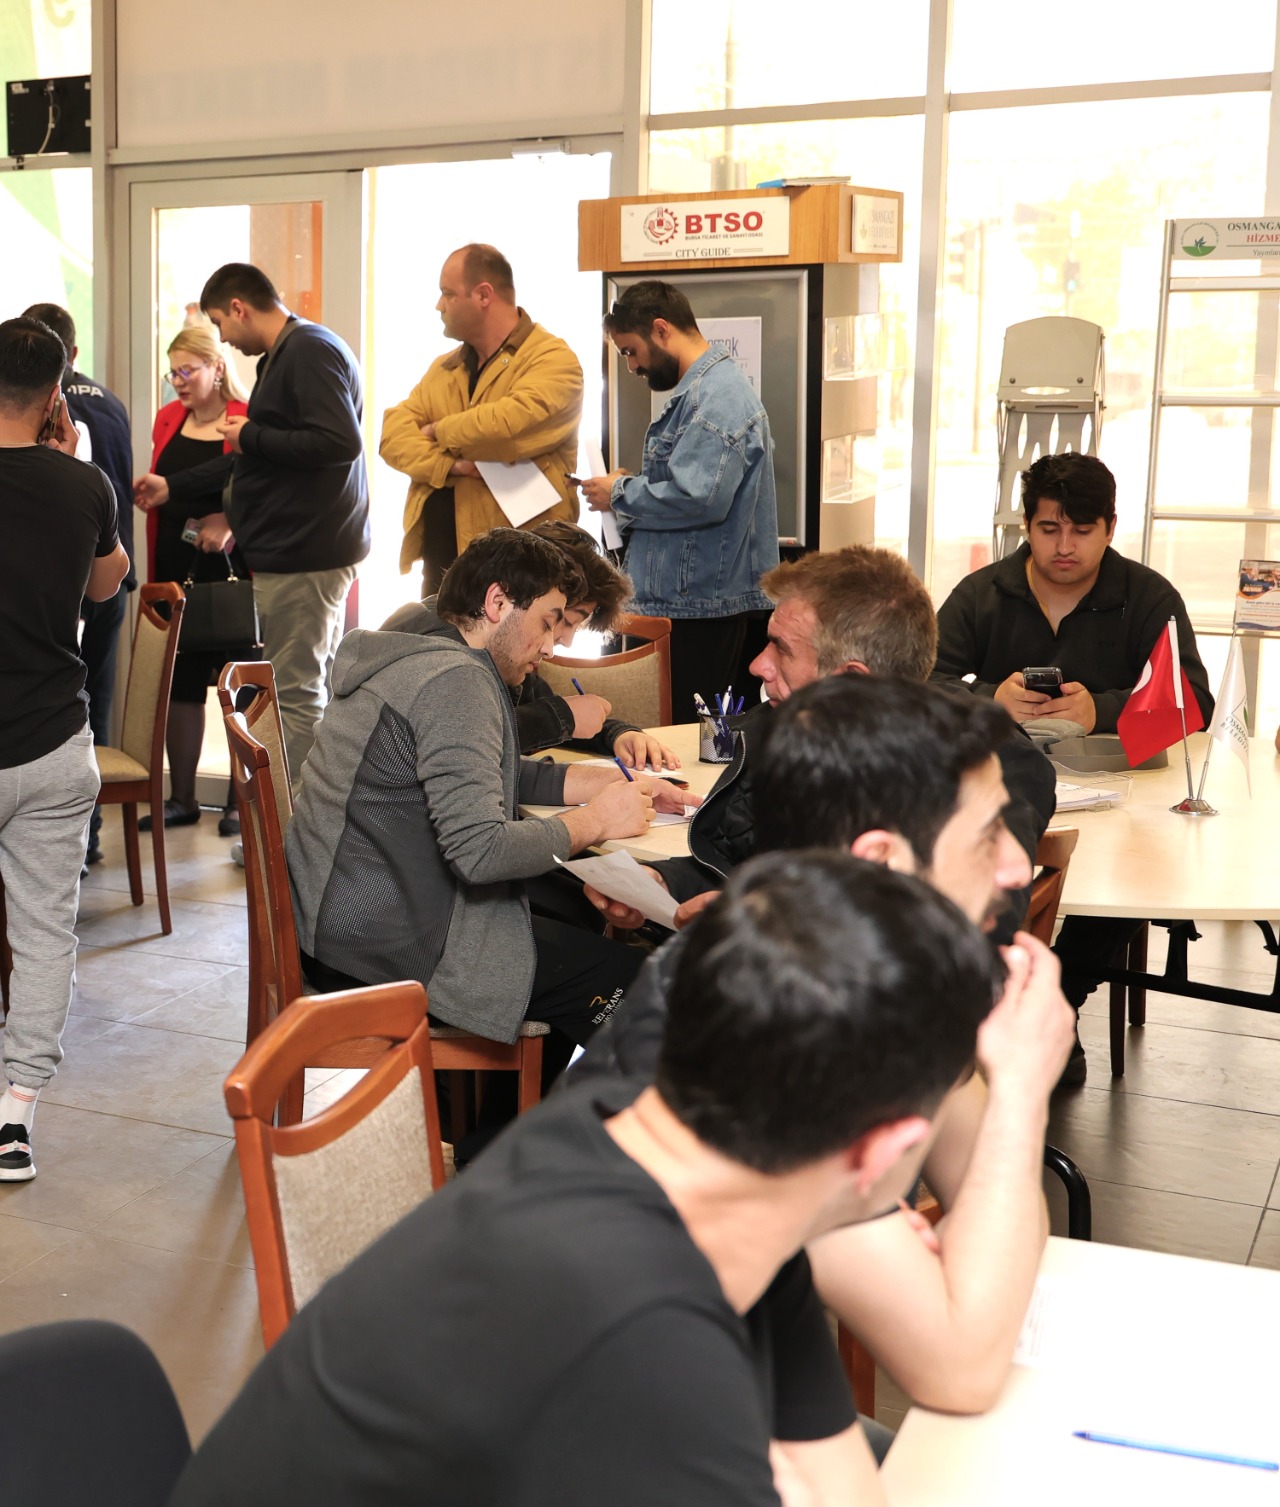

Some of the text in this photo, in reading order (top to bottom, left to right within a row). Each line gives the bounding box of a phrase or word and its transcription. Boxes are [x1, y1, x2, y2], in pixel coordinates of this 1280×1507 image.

[685, 211, 763, 234] BTSO
[675, 247, 731, 258] CITY GUIDE
